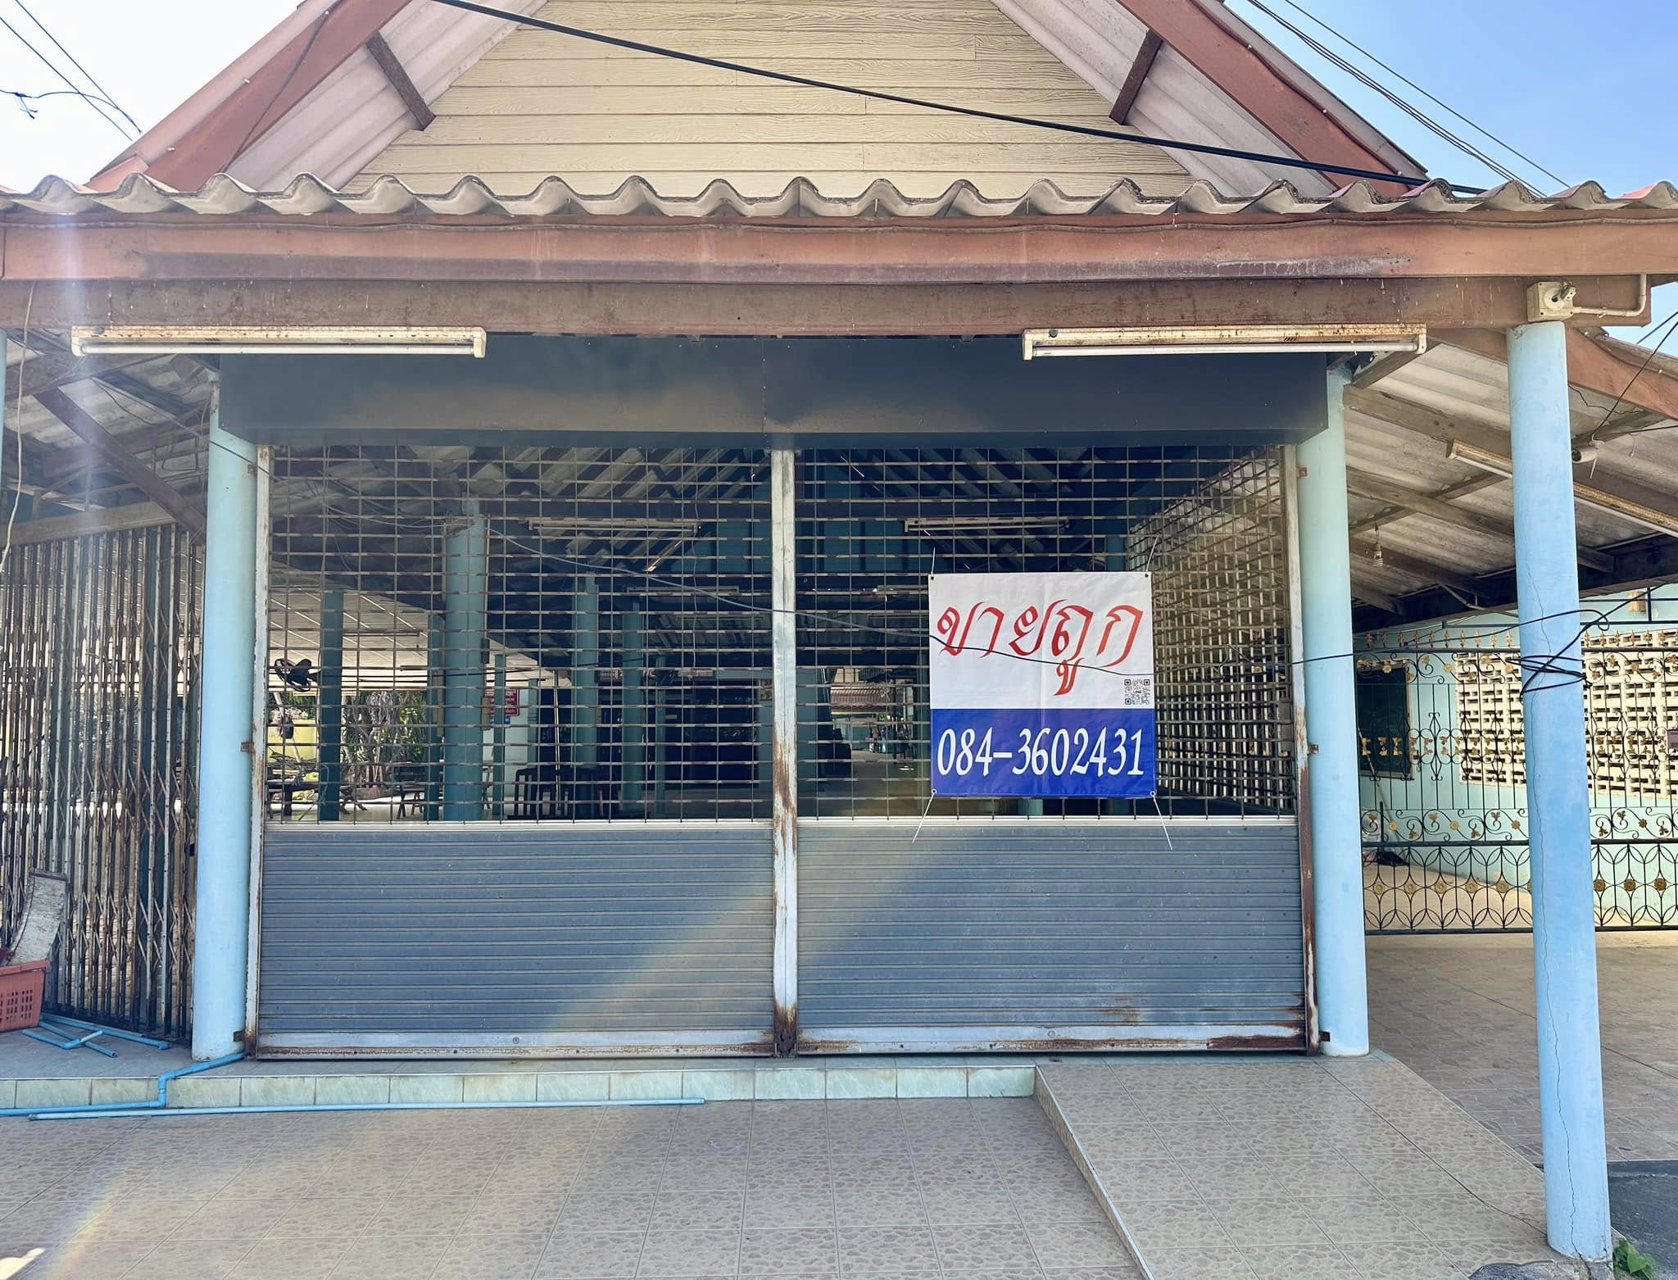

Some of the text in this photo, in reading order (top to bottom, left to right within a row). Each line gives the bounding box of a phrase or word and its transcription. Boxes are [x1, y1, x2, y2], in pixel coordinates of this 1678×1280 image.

[937, 599, 1144, 696] ขายถูก
[937, 727, 1144, 777] 084-3602431
